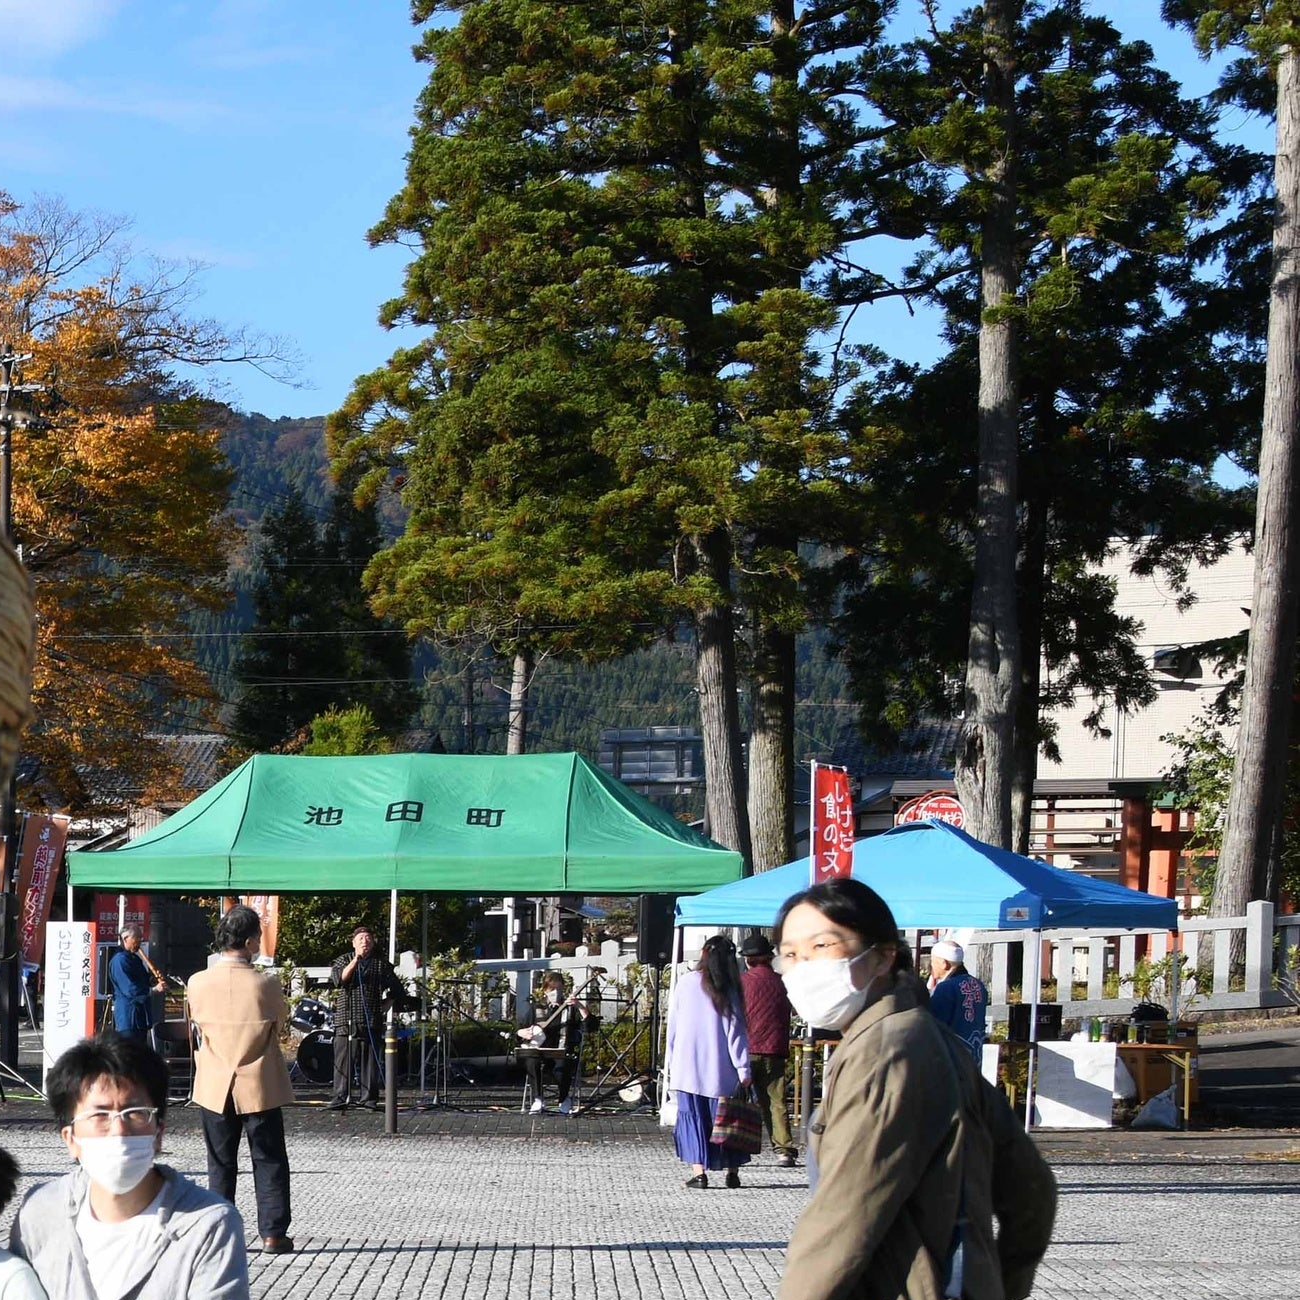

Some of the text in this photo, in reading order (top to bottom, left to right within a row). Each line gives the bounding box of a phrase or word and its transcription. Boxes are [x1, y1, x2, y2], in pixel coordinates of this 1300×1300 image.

[303, 800, 506, 828] 池田町
[820, 791, 841, 881] 食の文
[835, 781, 853, 852] いけだ
[58, 929, 72, 1028] いけだレコードライブ
[81, 931, 91, 997] 食の文化祭
